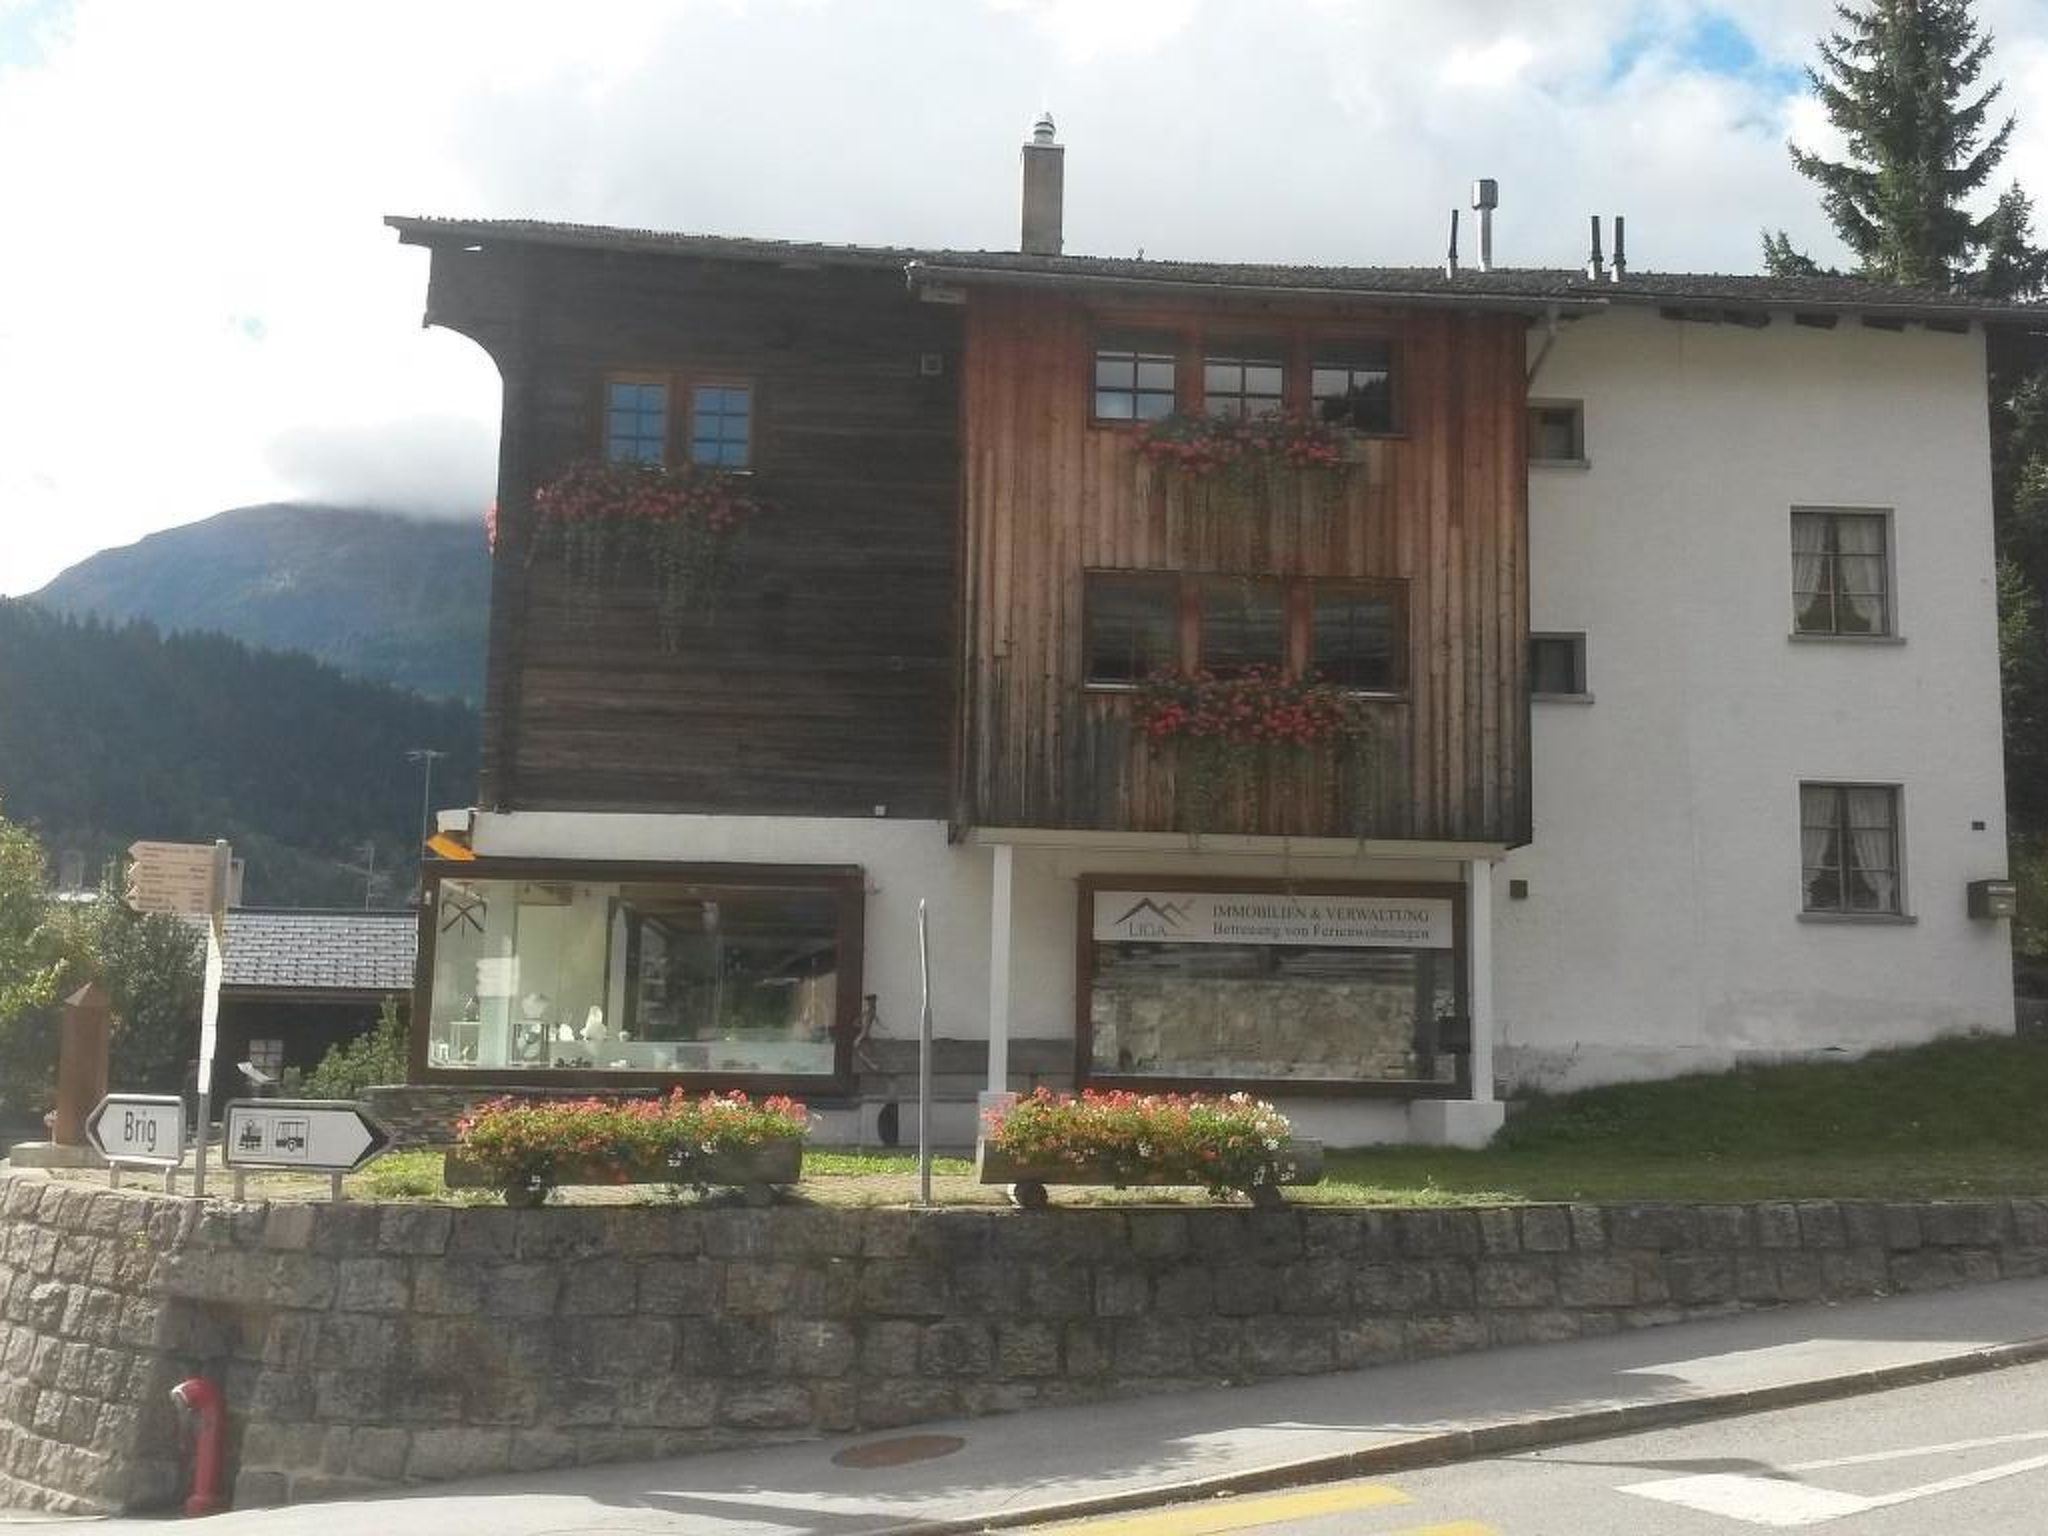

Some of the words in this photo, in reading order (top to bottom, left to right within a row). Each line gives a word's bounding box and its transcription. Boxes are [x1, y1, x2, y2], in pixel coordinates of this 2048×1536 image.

[1213, 905, 1306, 919] IMMOBILIEN
[1311, 908, 1321, 919] &
[1326, 908, 1429, 922] VERWALTUNG
[1213, 921, 1279, 938] Betreuung
[1287, 926, 1309, 937] von
[1314, 923, 1429, 941] Ferienwohnungen
[124, 1110, 156, 1152] Brig
